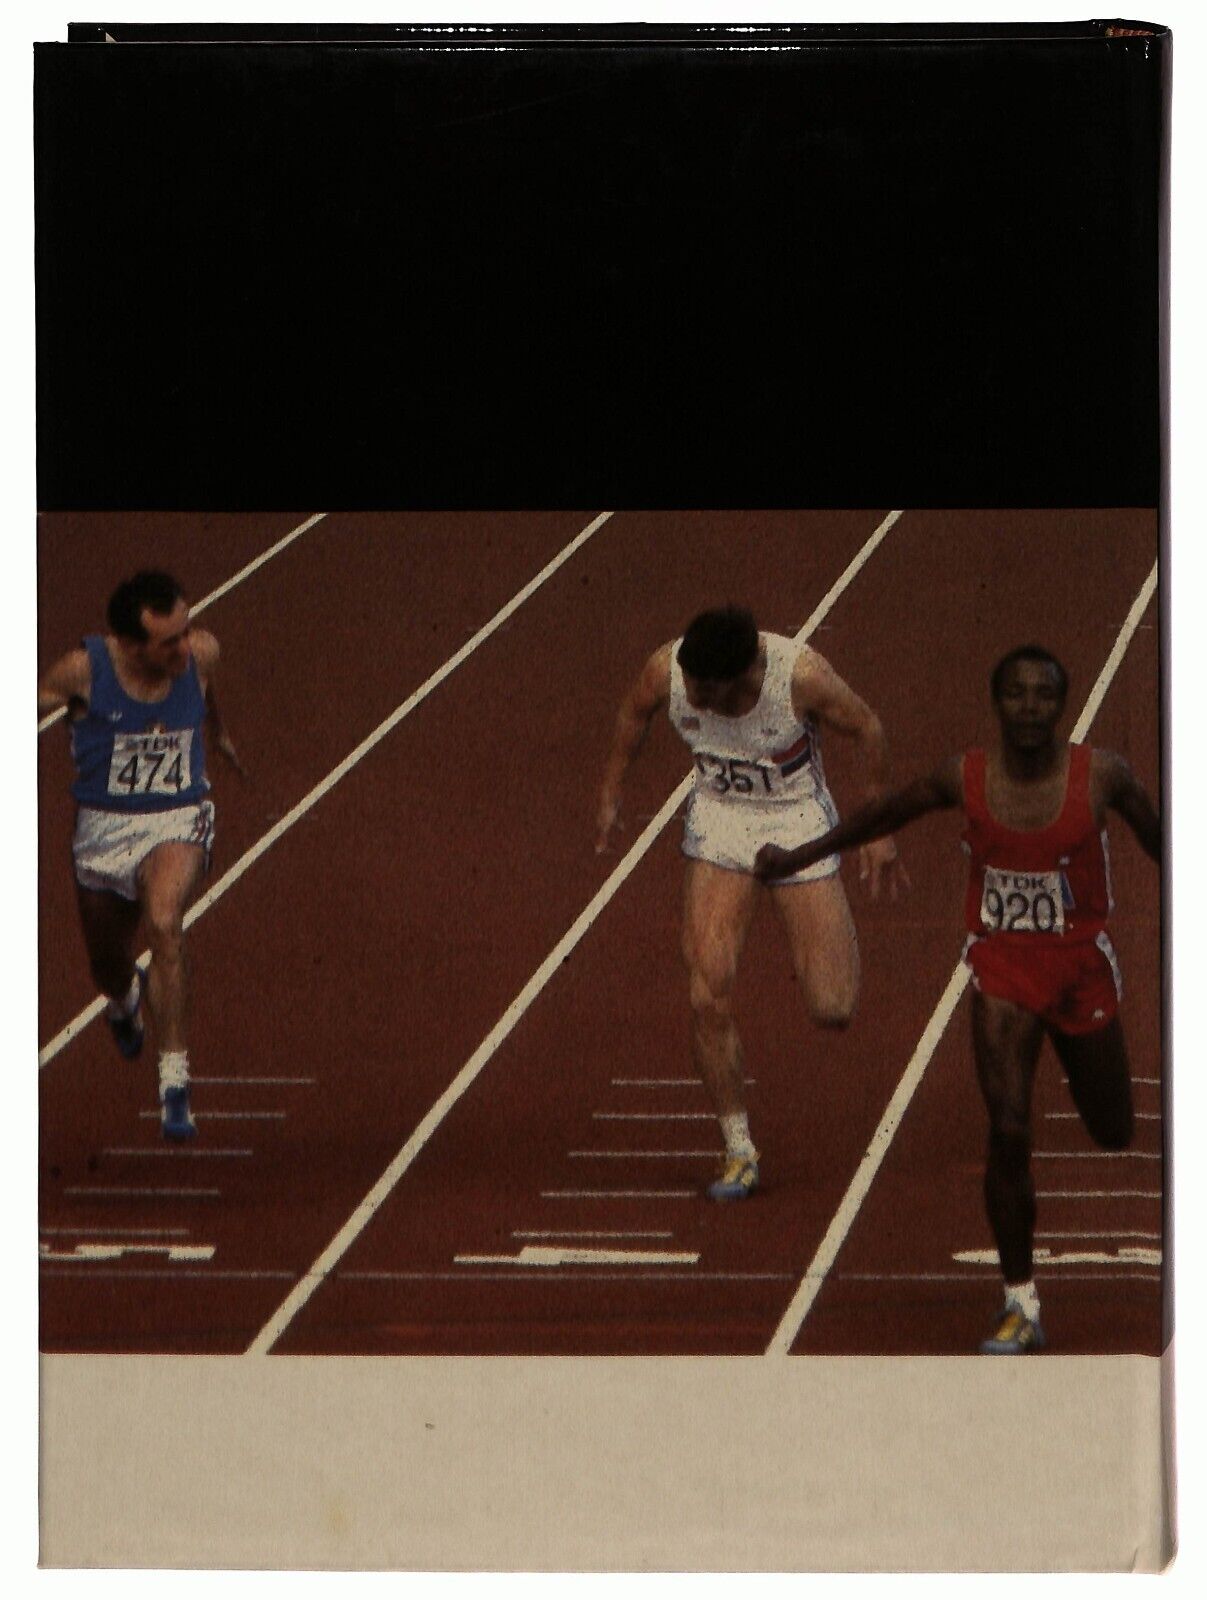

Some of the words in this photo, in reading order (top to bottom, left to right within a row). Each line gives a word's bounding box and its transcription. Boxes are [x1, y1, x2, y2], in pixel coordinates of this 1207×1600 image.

[117, 753, 184, 793] 474
[998, 875, 1046, 890] TDK
[984, 888, 1057, 932] 920
